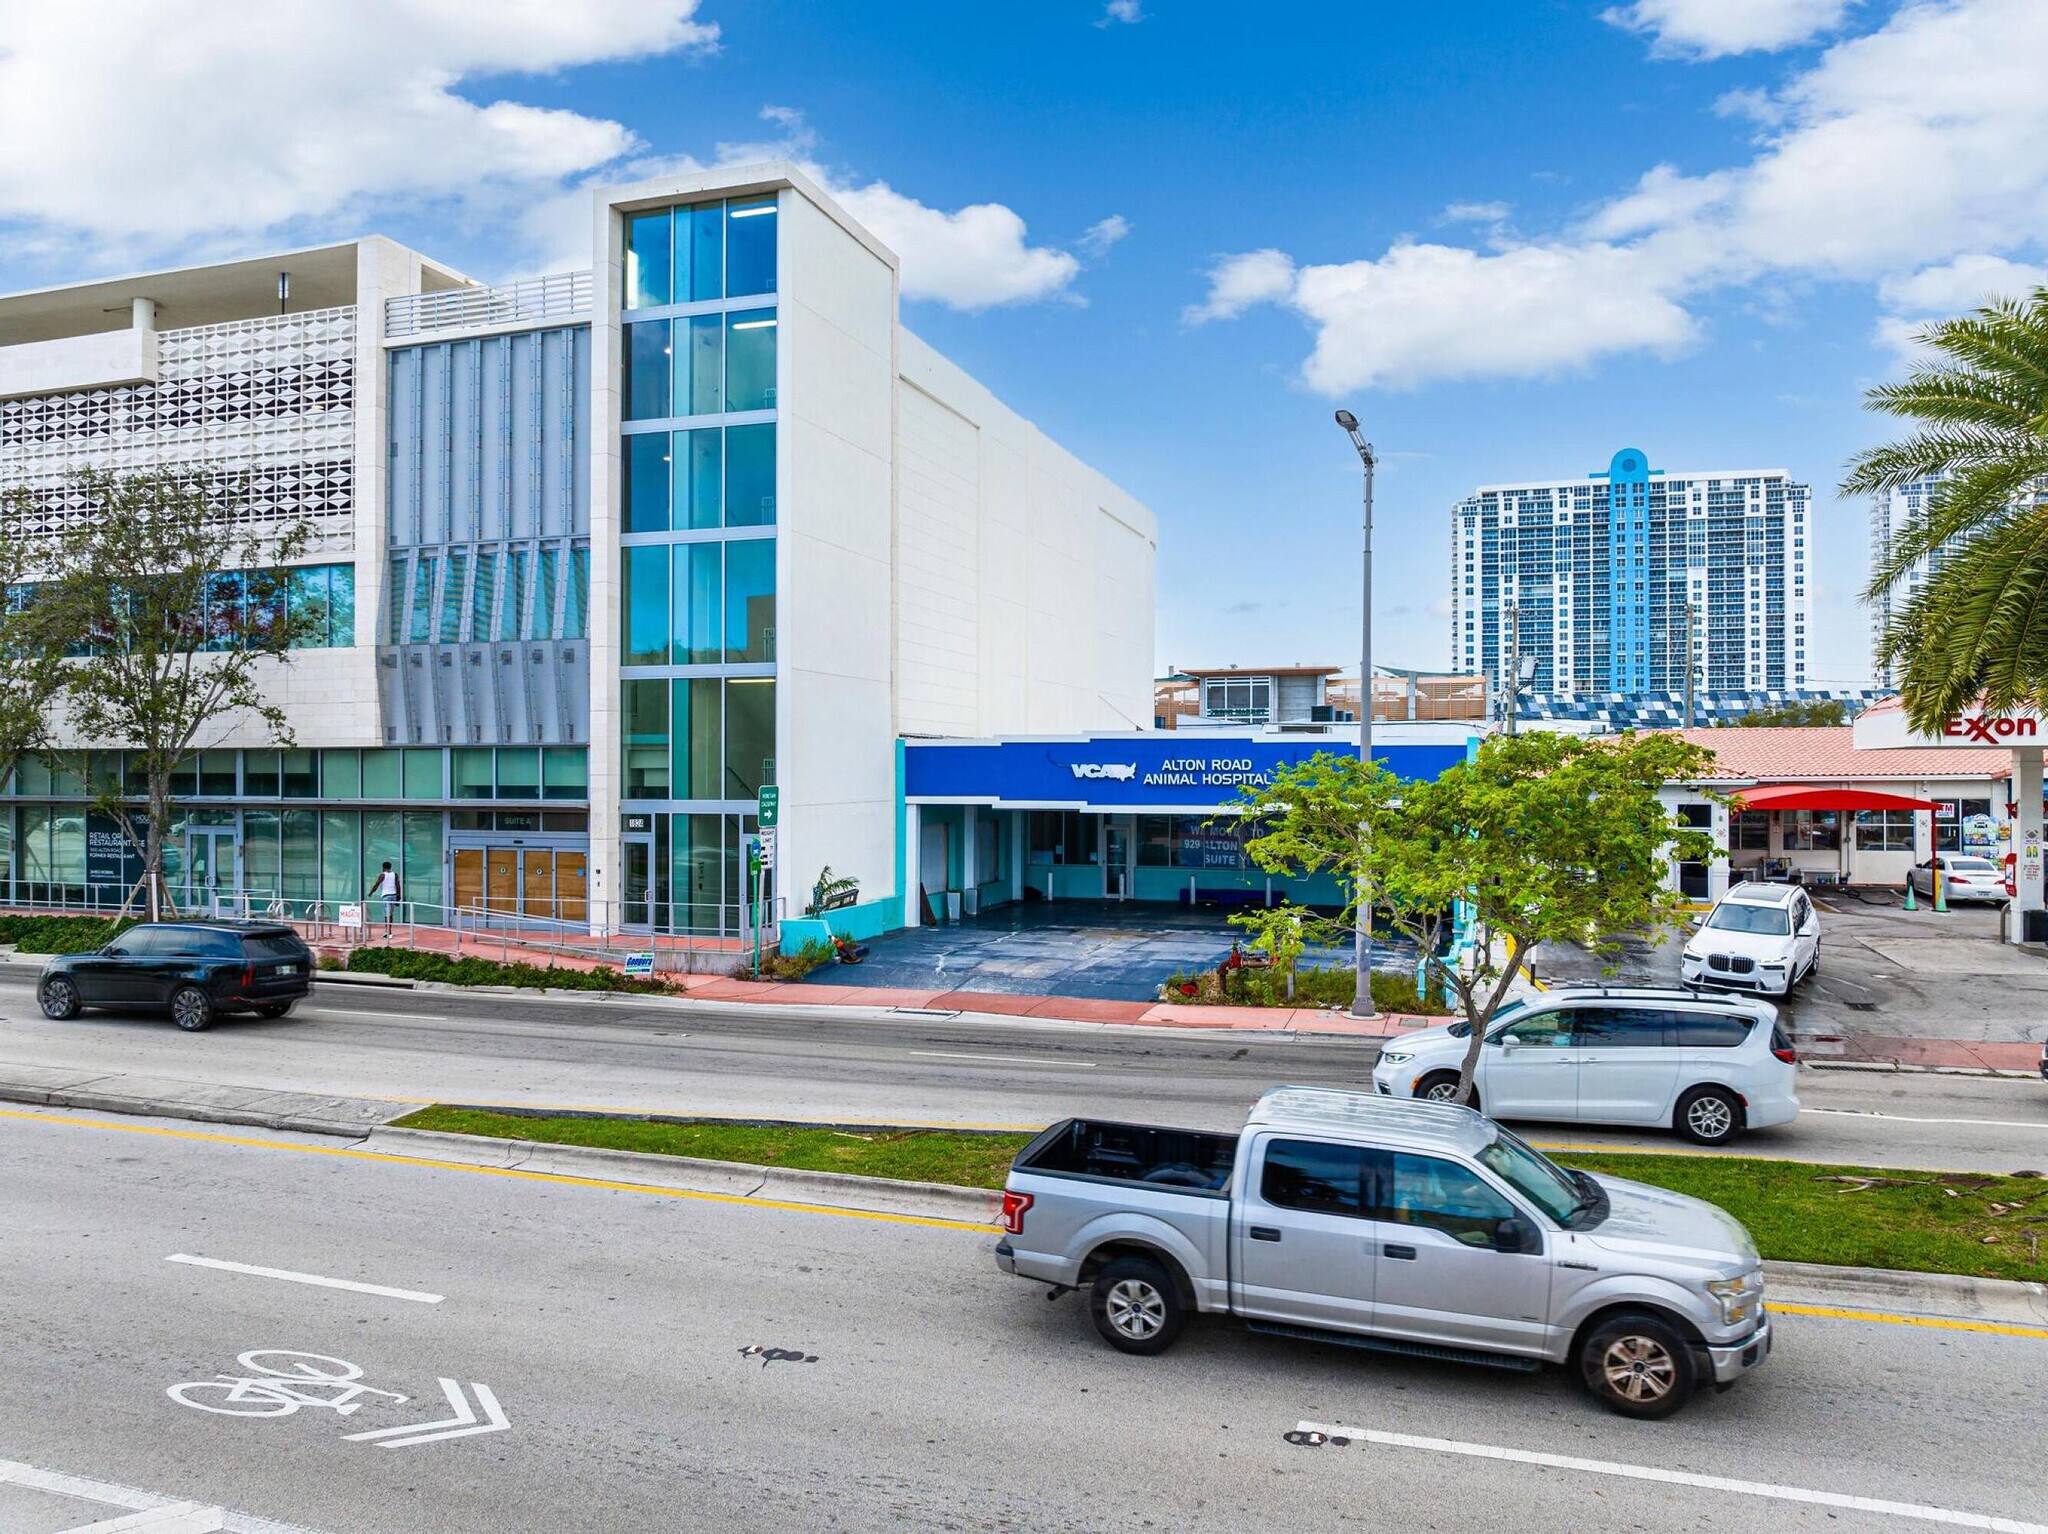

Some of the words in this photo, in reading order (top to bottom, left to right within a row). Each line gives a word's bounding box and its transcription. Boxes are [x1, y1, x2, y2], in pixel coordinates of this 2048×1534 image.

[1944, 712, 2036, 744] Exxon
[1071, 763, 1116, 779] VCA
[1162, 759, 1206, 771] ALTON
[1211, 759, 1252, 771] ROAD
[1143, 773, 1198, 785] ANIMAL
[1202, 773, 1272, 786] HOSPITAL
[504, 817, 525, 825] SUITE
[526, 817, 532, 825] A
[1184, 839, 1201, 849] 929
[1205, 854, 1236, 865] SUITE
